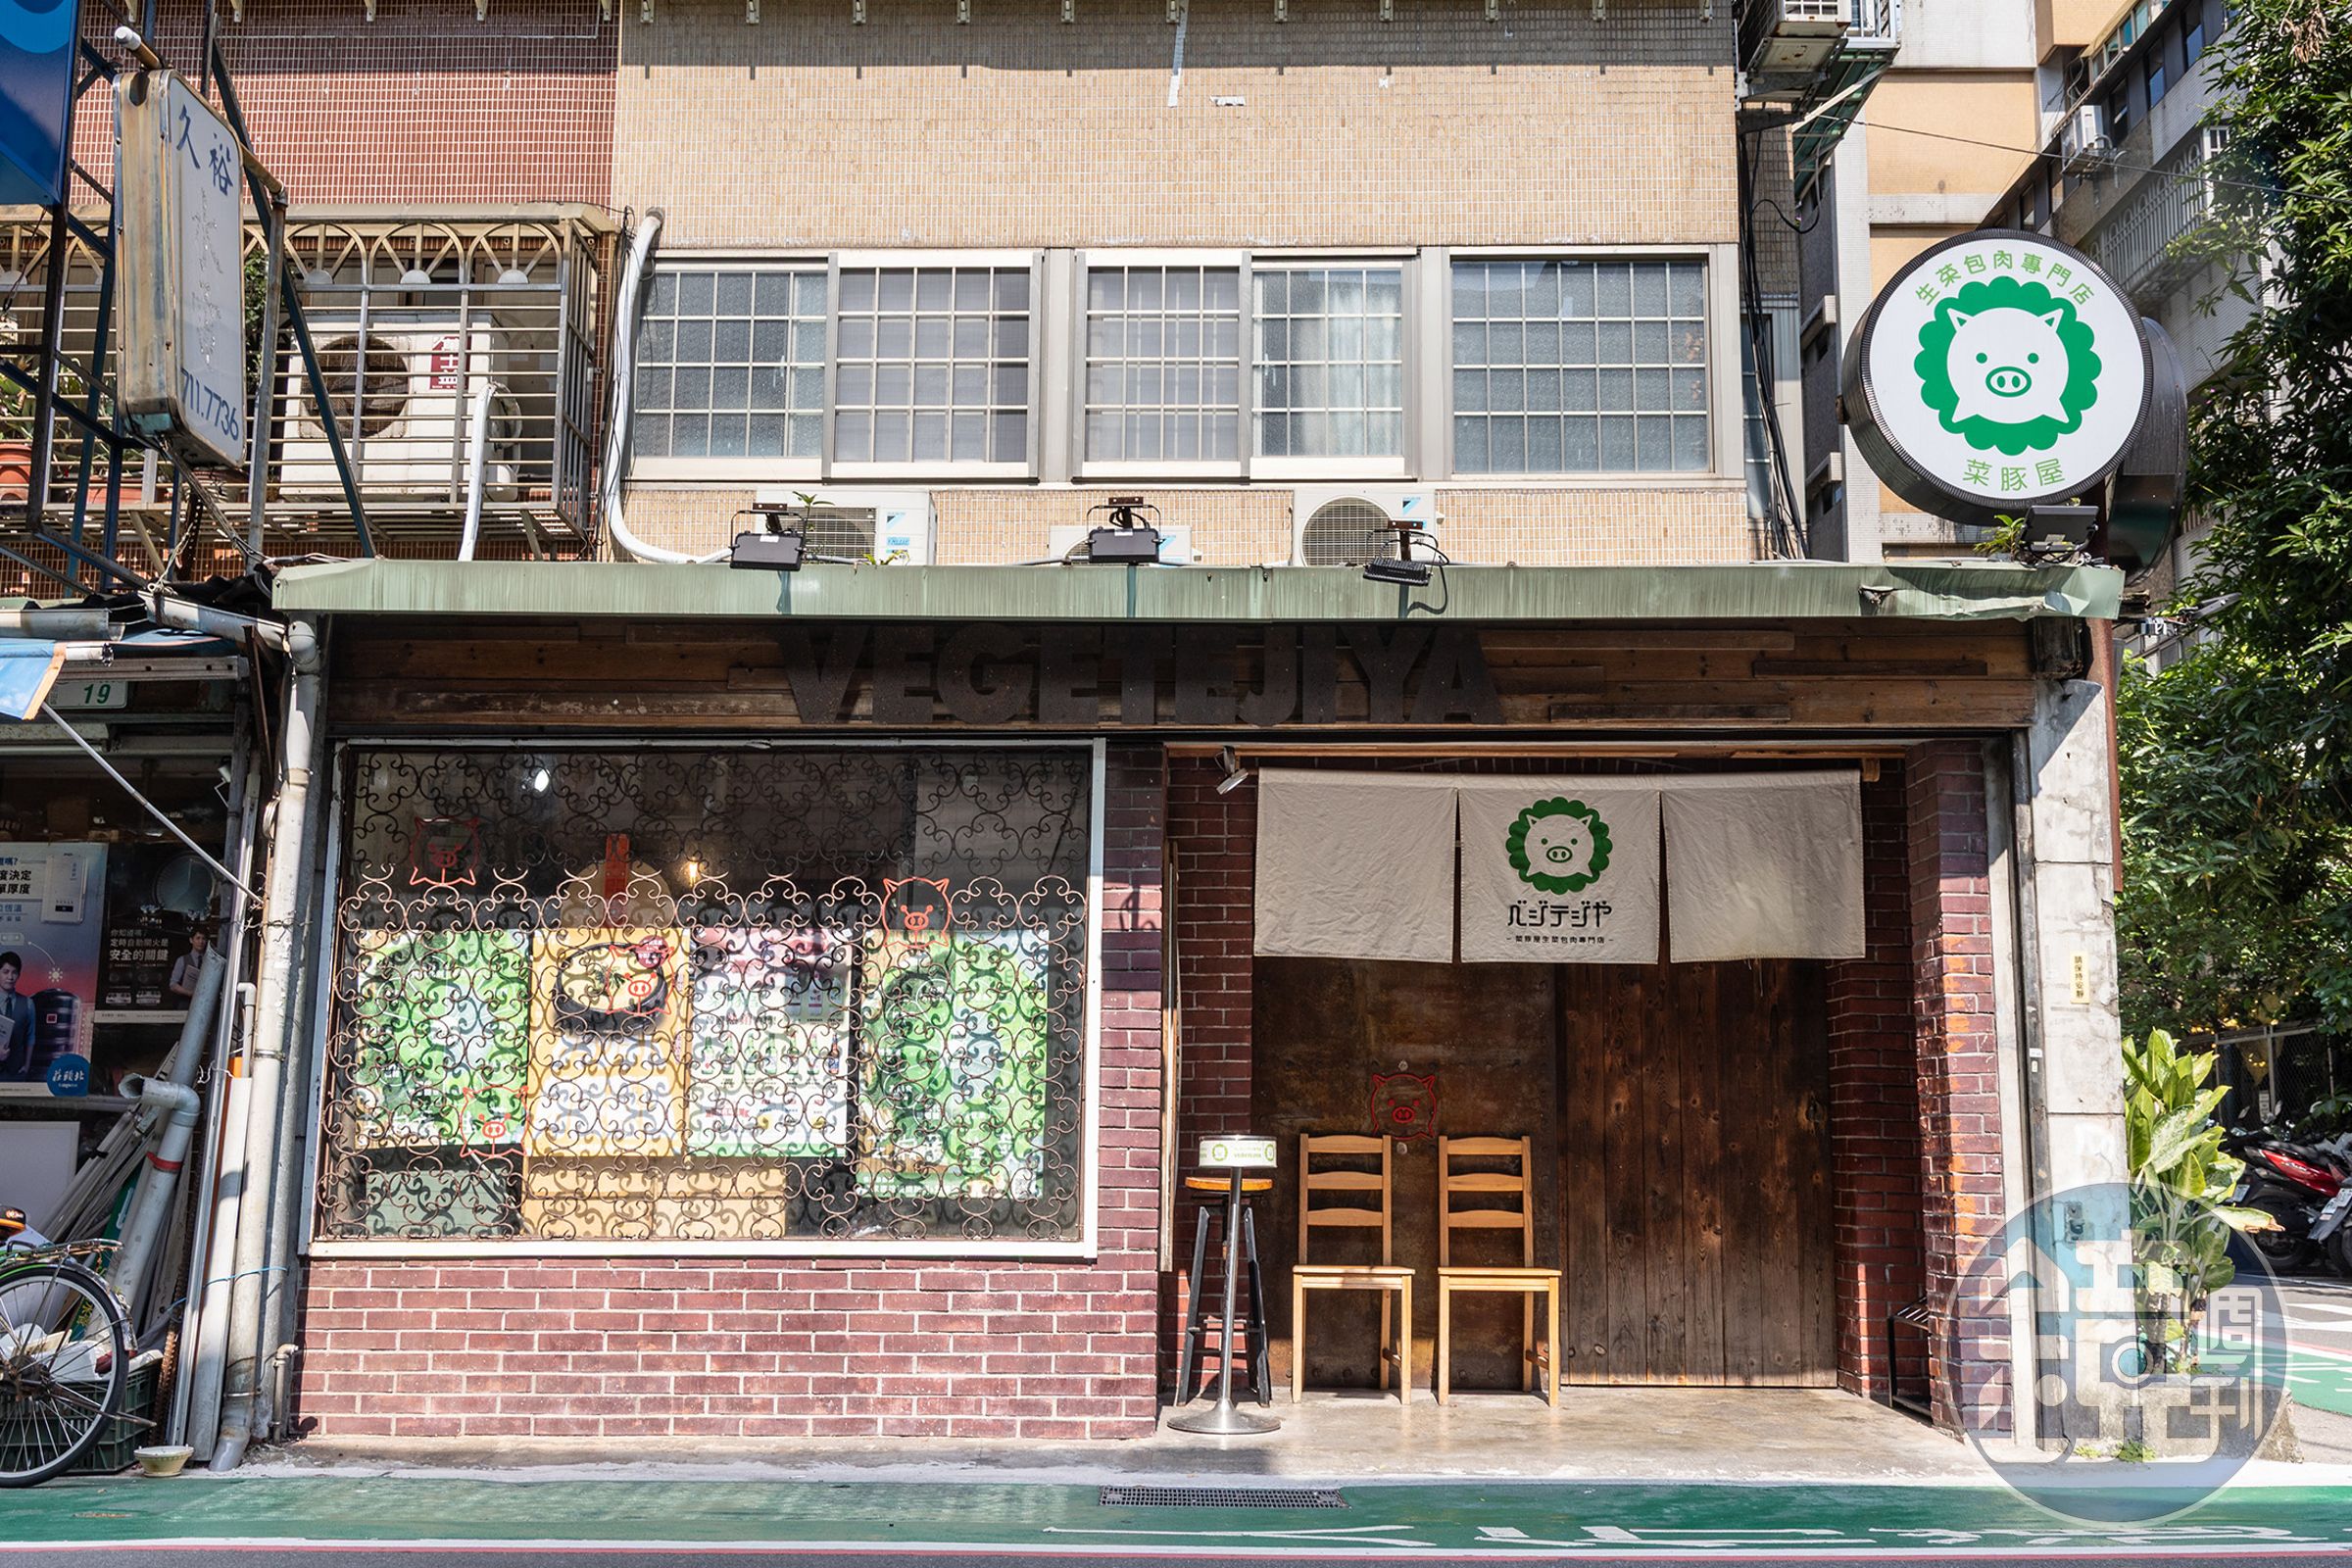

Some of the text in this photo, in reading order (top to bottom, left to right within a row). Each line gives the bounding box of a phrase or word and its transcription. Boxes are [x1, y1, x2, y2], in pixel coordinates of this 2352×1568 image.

[1914, 249, 2095, 307] 生菜包肉專門店
[1962, 457, 2066, 492] 菜豚屋
[779, 624, 1506, 725] VEGETEJIYA
[84, 683, 112, 705] 19
[109, 949, 170, 961] 安全的關鍵
